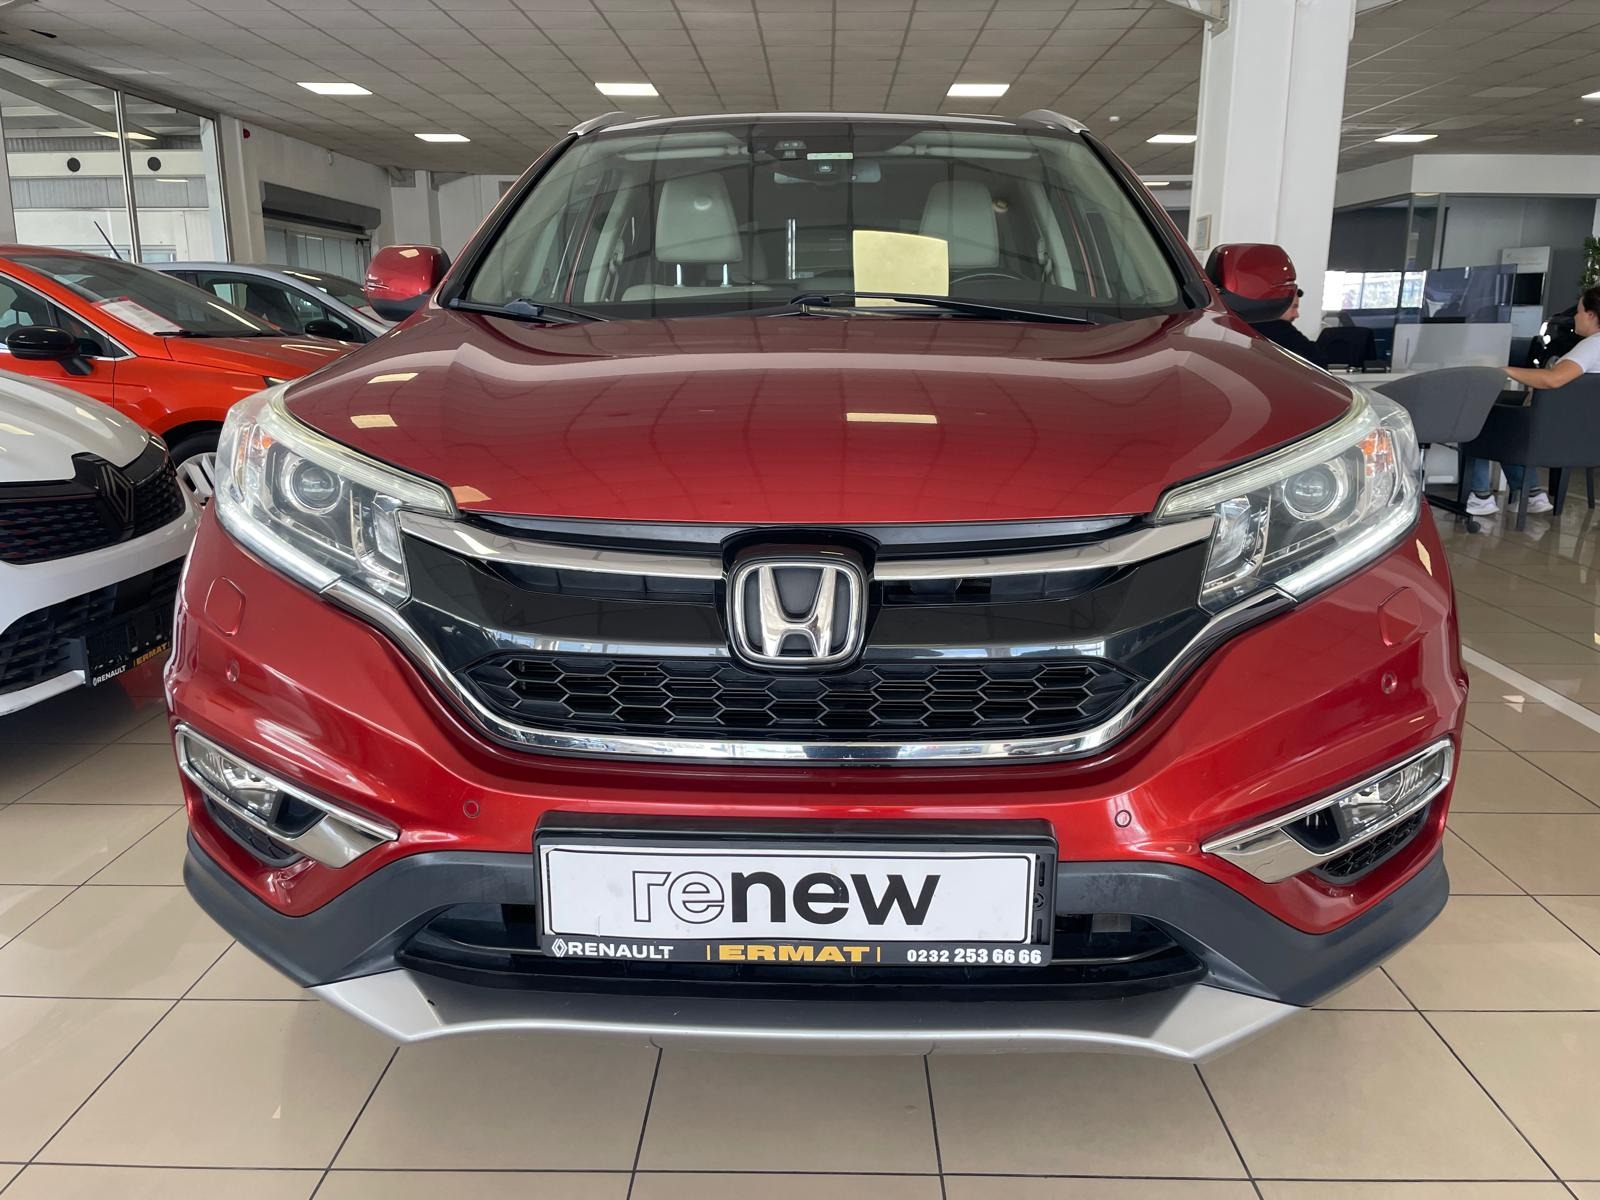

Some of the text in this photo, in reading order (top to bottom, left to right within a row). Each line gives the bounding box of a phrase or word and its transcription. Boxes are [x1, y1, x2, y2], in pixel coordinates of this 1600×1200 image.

[97, 642, 168, 684] RENAULT ERMAT
[631, 869, 941, 926] renew
[567, 941, 1042, 965] RENAULT ERMAT 0232 253 66 66
